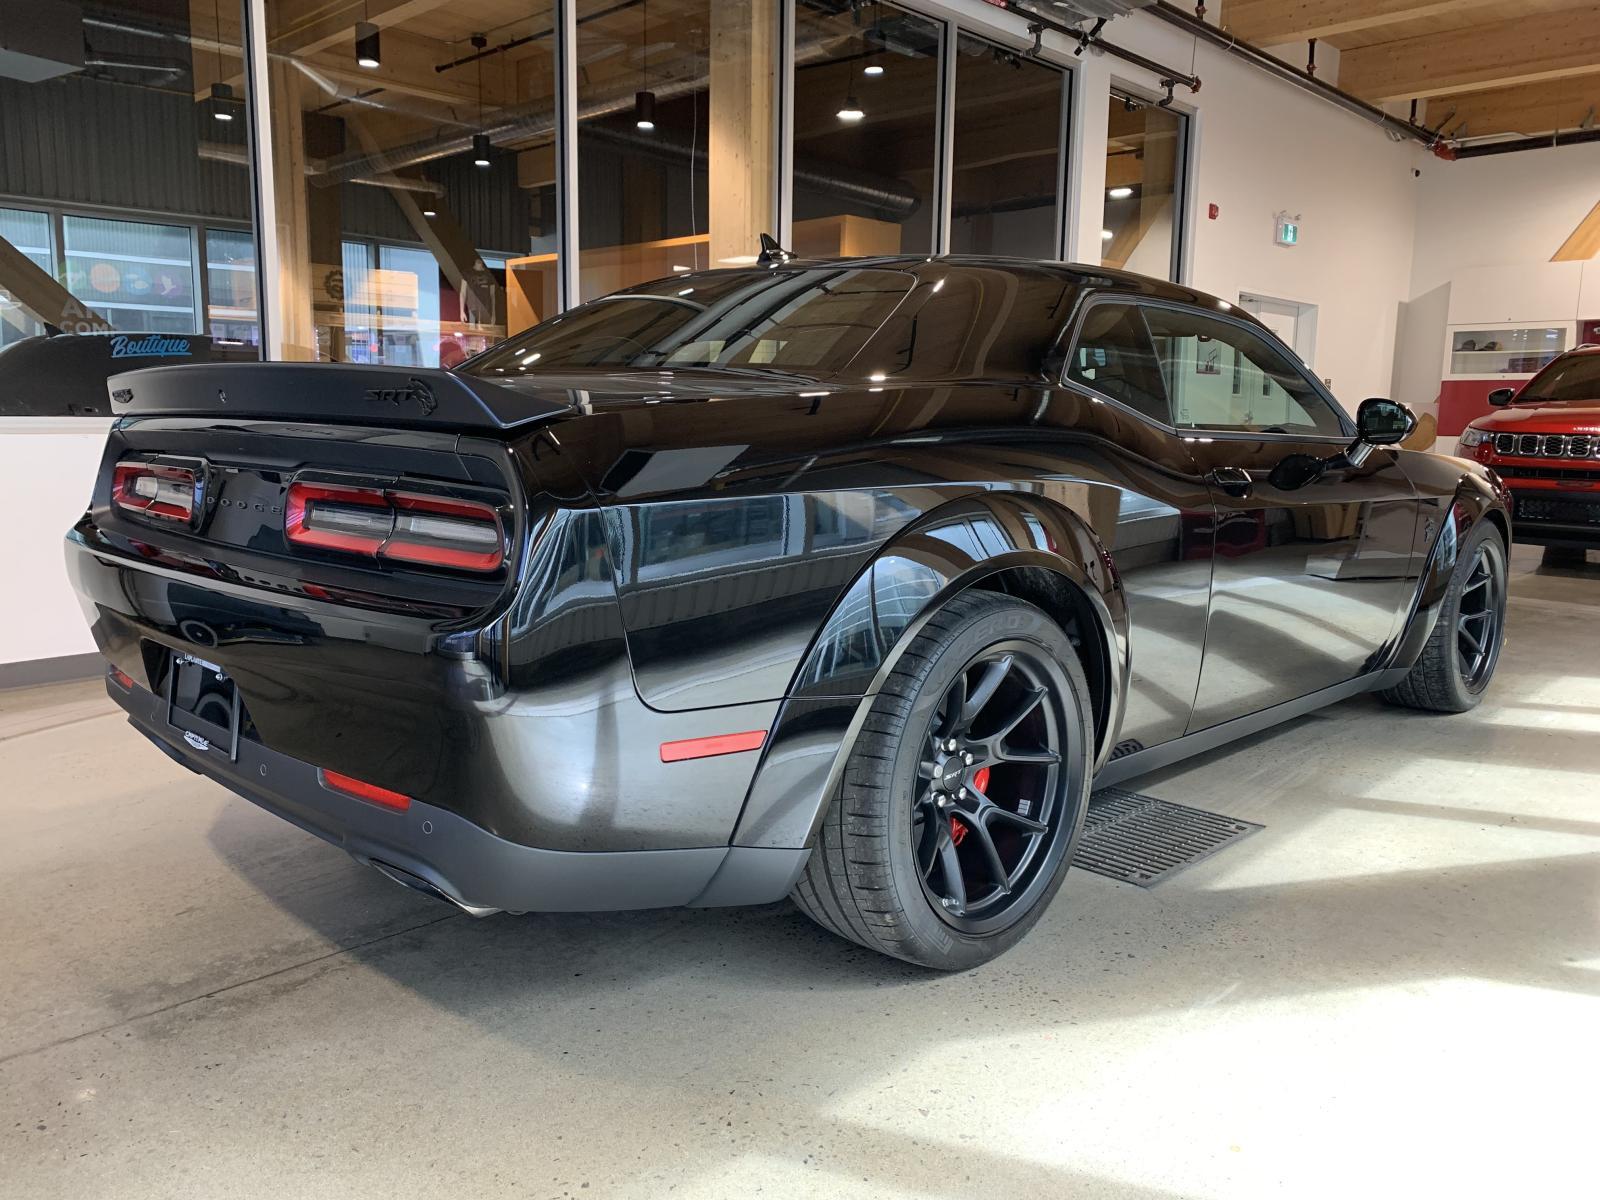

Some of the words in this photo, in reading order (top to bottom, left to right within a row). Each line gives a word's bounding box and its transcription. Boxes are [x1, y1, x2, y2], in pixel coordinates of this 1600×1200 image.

[110, 334, 192, 358] Boutique
[207, 496, 282, 514] DODGE
[943, 769, 961, 781] SRT
